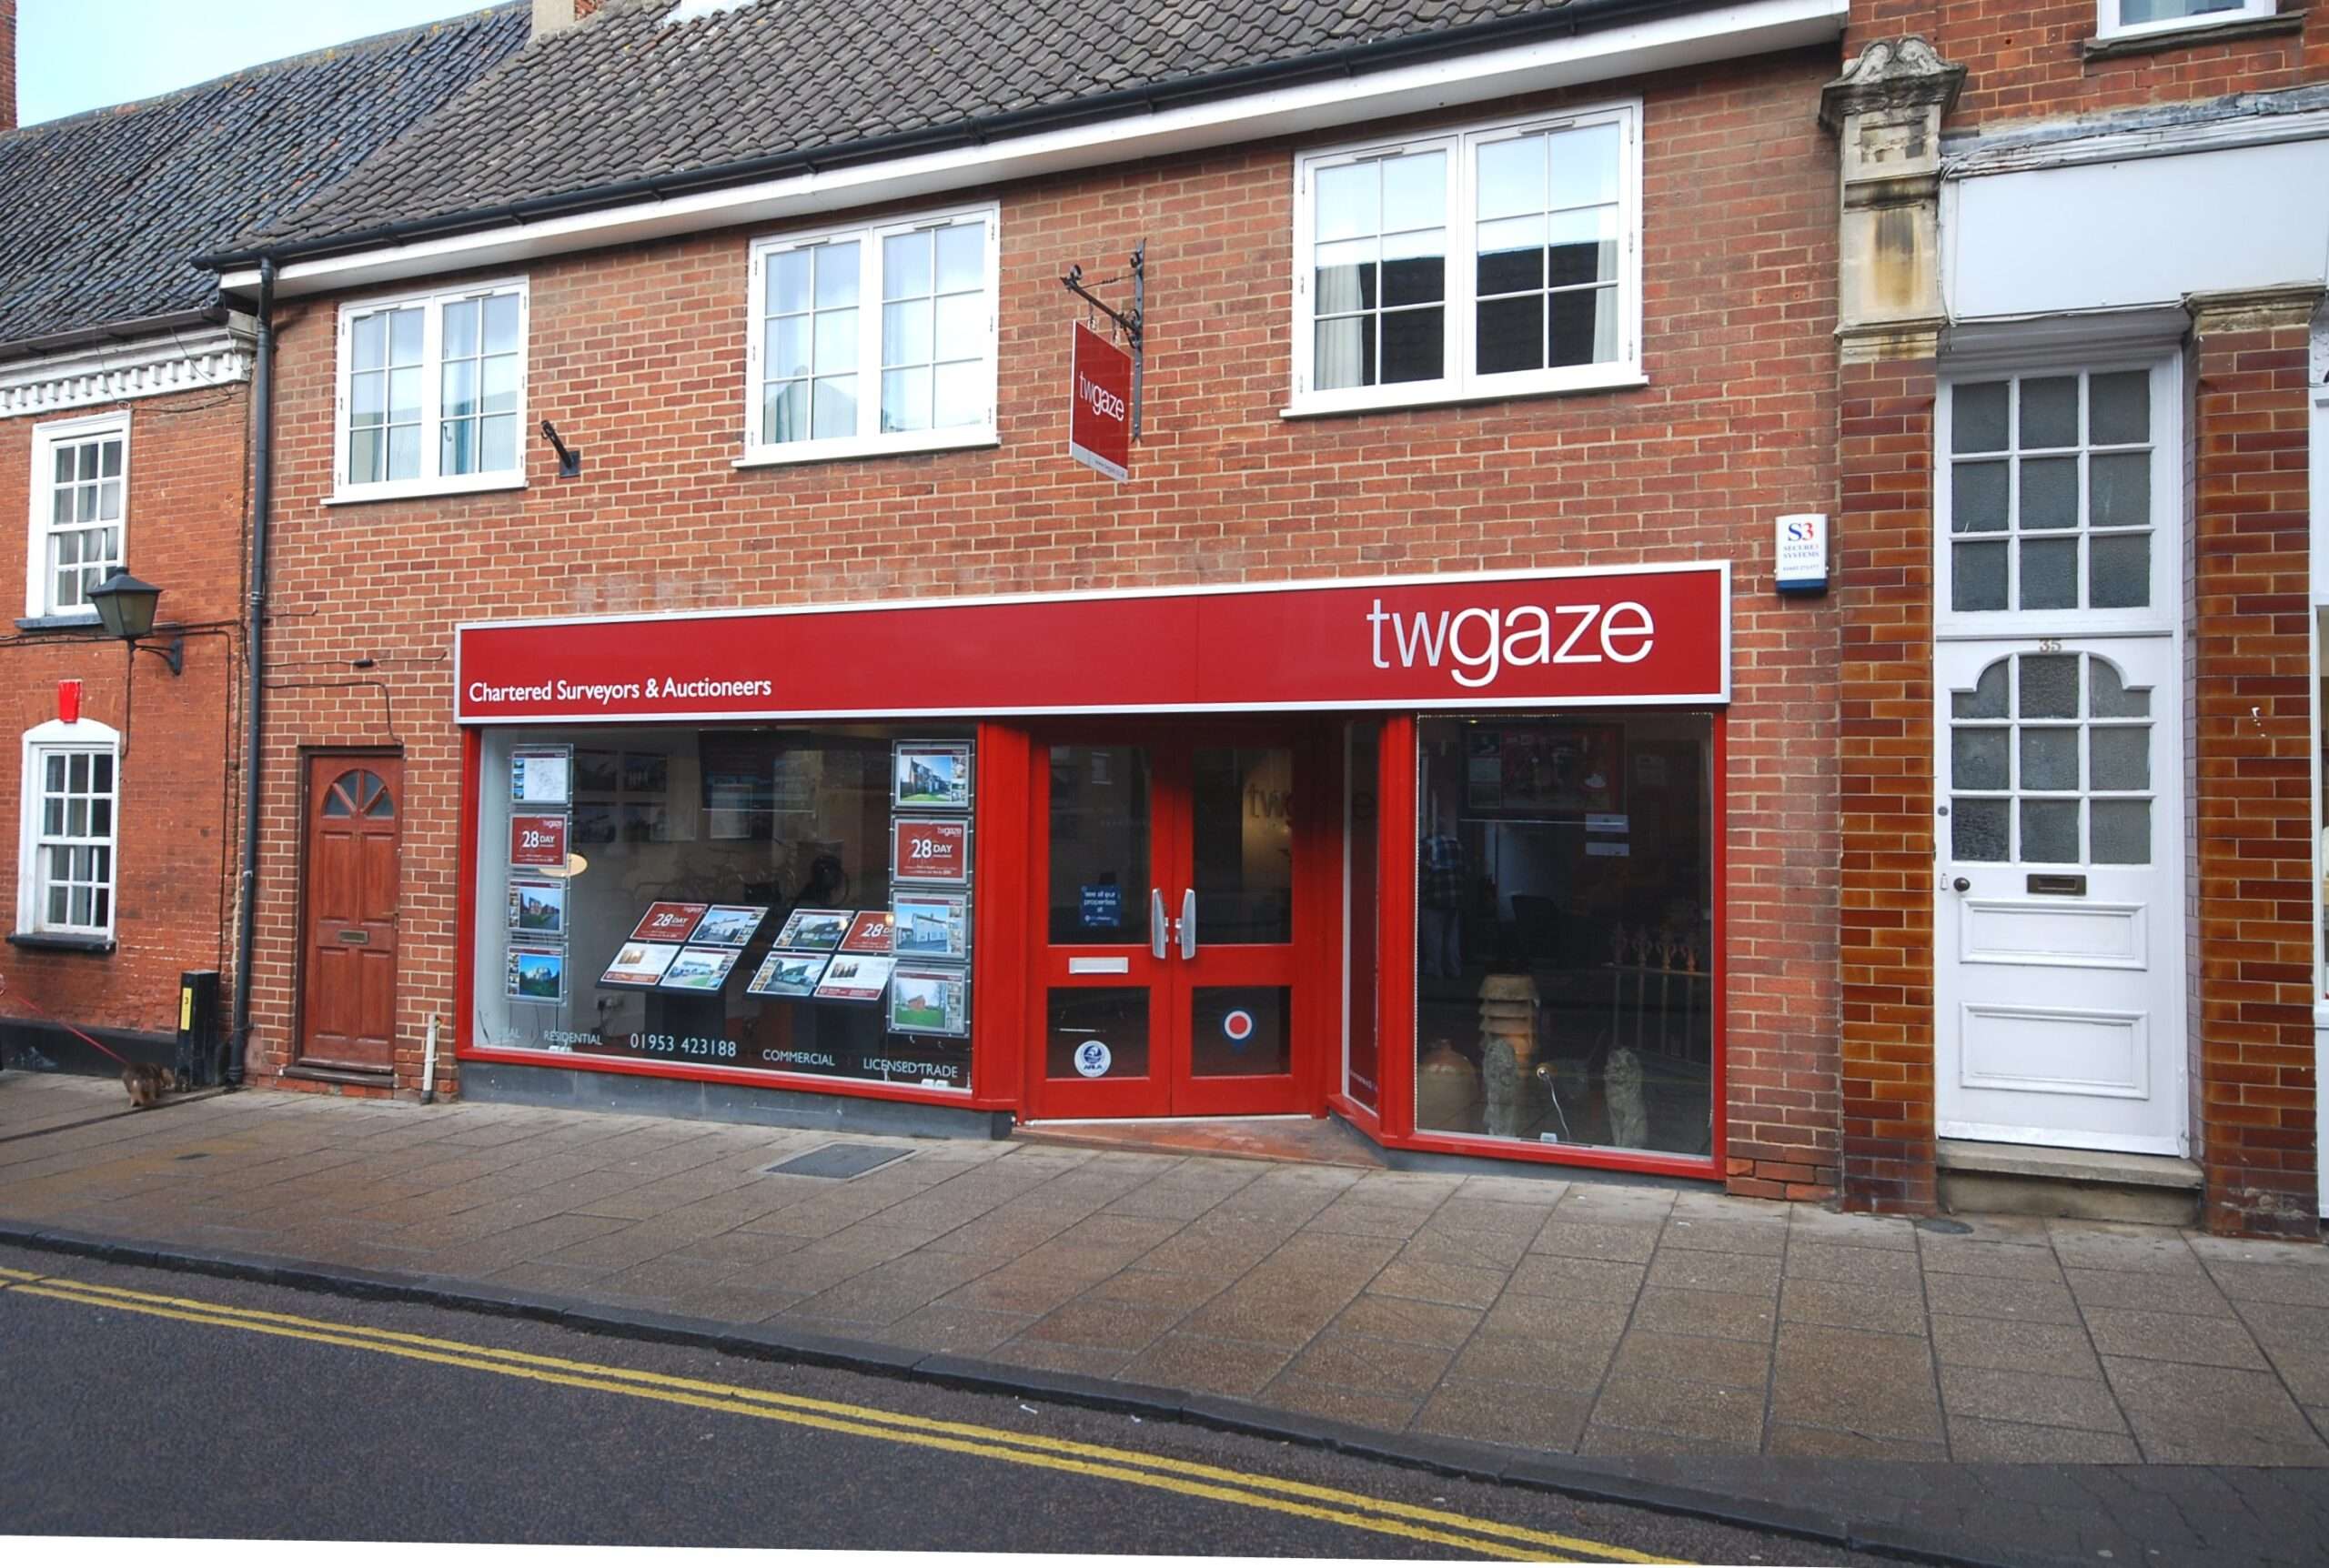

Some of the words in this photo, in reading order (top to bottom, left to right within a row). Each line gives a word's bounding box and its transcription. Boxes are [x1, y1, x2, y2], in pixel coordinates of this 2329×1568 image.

[1079, 370, 1124, 422] twgaze
[1788, 522, 1814, 542] S3
[1366, 598, 1654, 688] twgaze
[469, 680, 551, 702] Chartered
[557, 679, 640, 705] Surveyors
[645, 678, 659, 699] &
[662, 677, 771, 699] Auctioneers
[522, 830, 539, 848] 28
[539, 835, 555, 843] DAY
[911, 839, 933, 859] 28
[933, 844, 953, 853] DAY
[651, 913, 673, 927] 28
[860, 923, 883, 937] 28
[543, 1030, 603, 1046] RESIDENTIAL
[630, 1032, 675, 1052] 01953
[681, 1037, 737, 1058] 423188
[762, 1049, 836, 1067] COMMERCIAL
[863, 1058, 918, 1074] LICENSED
[919, 1063, 959, 1079] TRADE
